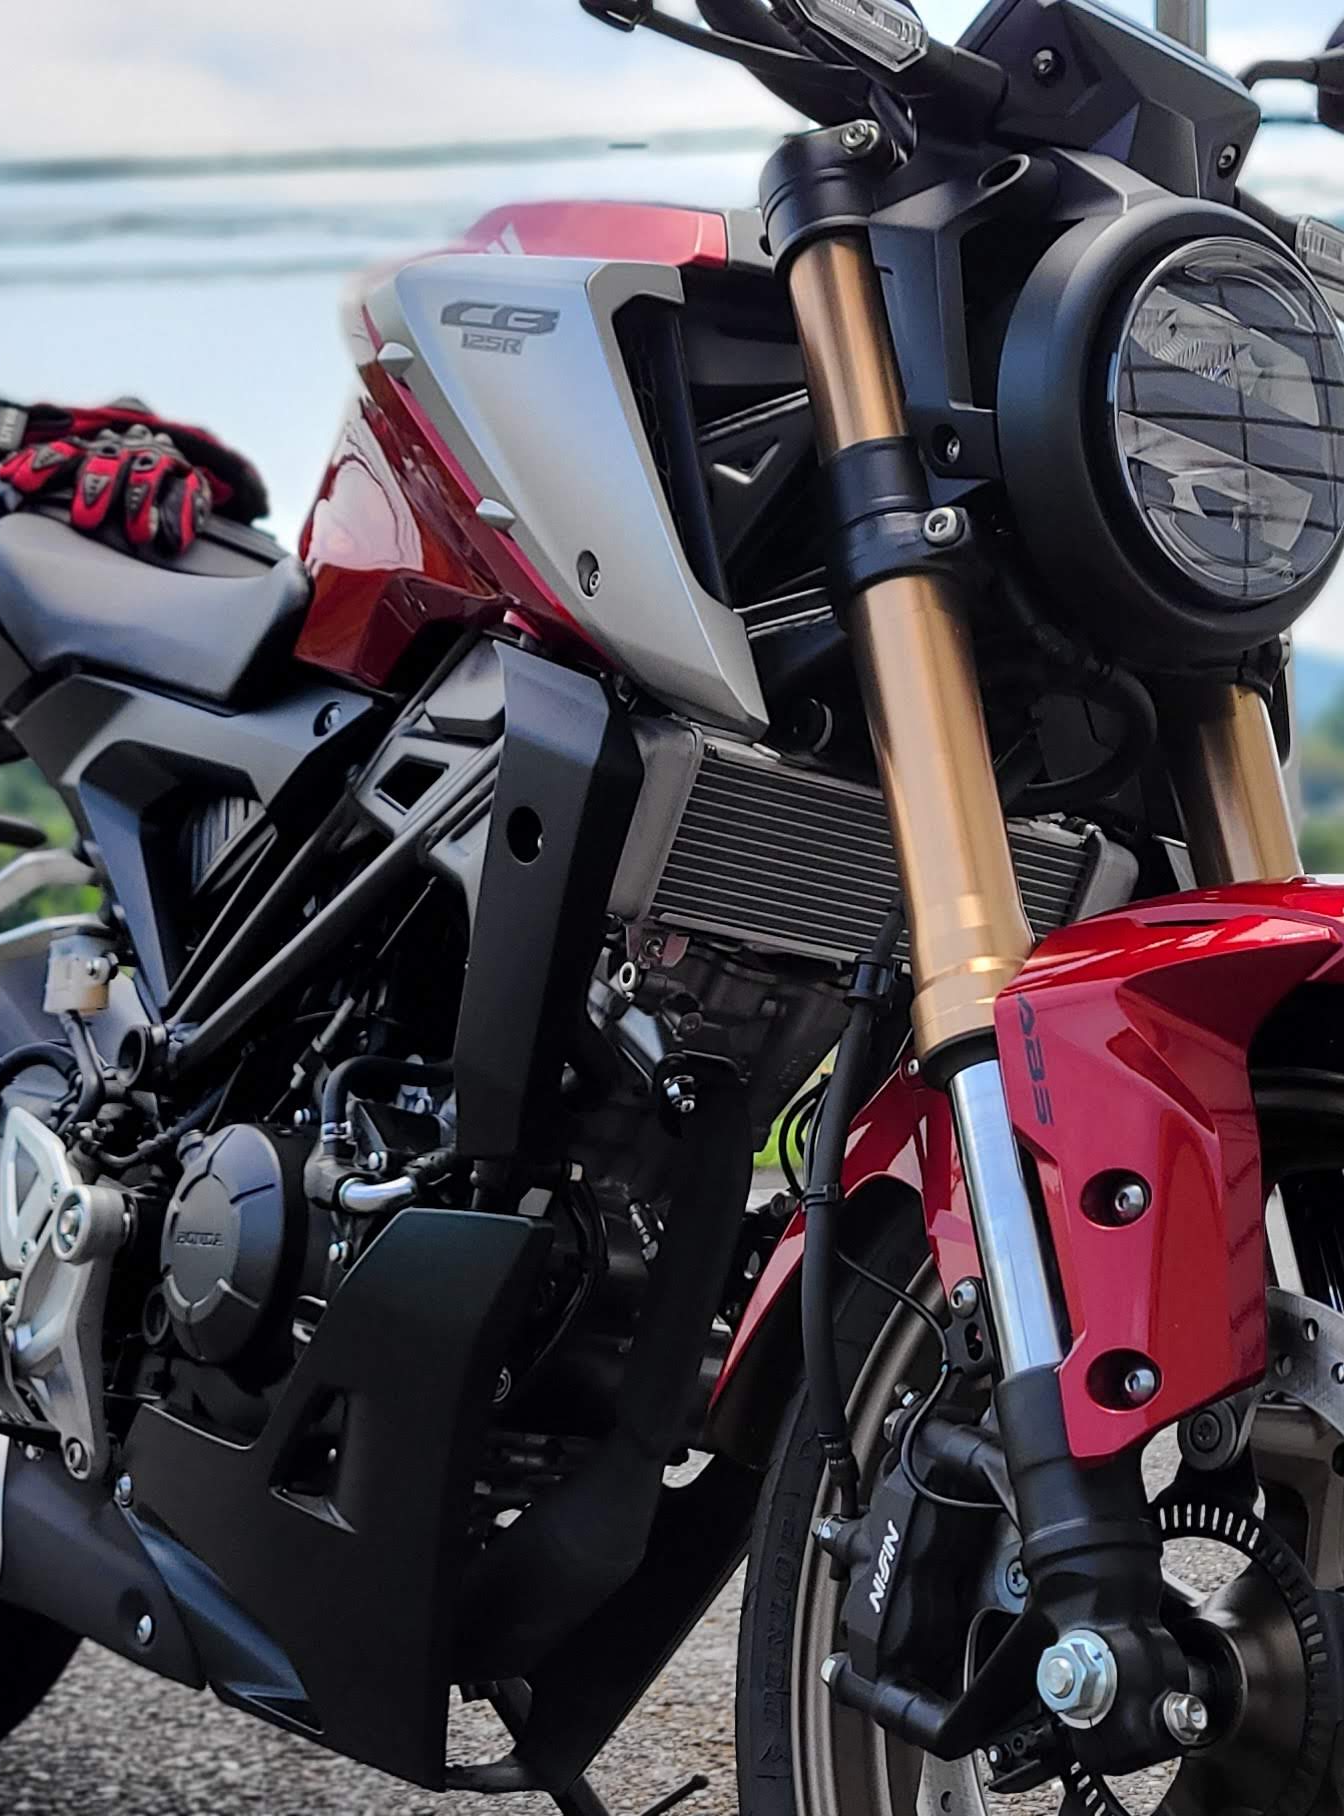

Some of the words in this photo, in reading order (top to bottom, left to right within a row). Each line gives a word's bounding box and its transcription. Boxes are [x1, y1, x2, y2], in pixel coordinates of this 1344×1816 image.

[440, 301, 560, 335] CB
[461, 332, 523, 355] 125R
[1016, 990, 1056, 1127] ABS
